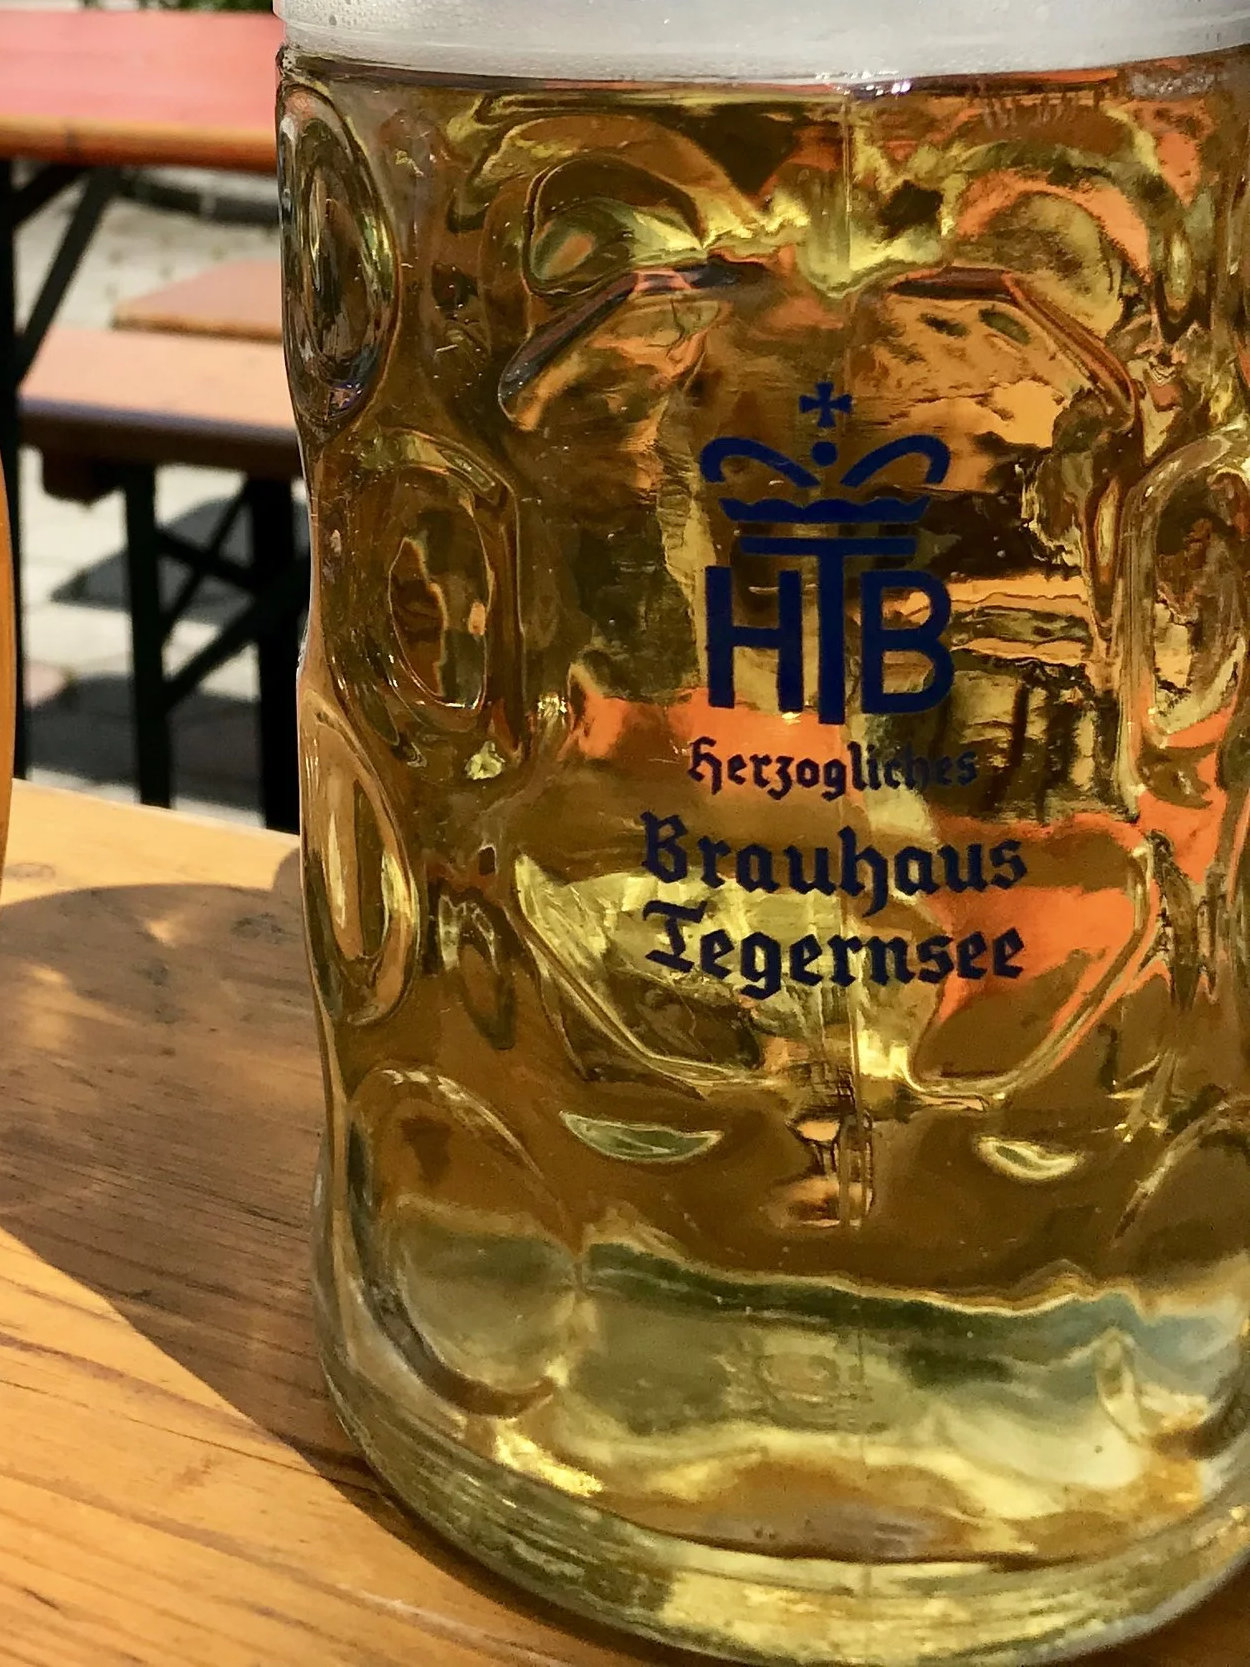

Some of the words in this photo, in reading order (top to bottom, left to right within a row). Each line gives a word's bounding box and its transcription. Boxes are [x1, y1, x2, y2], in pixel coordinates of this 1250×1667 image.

[687, 735, 979, 801] Herzogliches
[640, 811, 1028, 918] Brauhaus
[642, 898, 1025, 1000] Tegernsee
